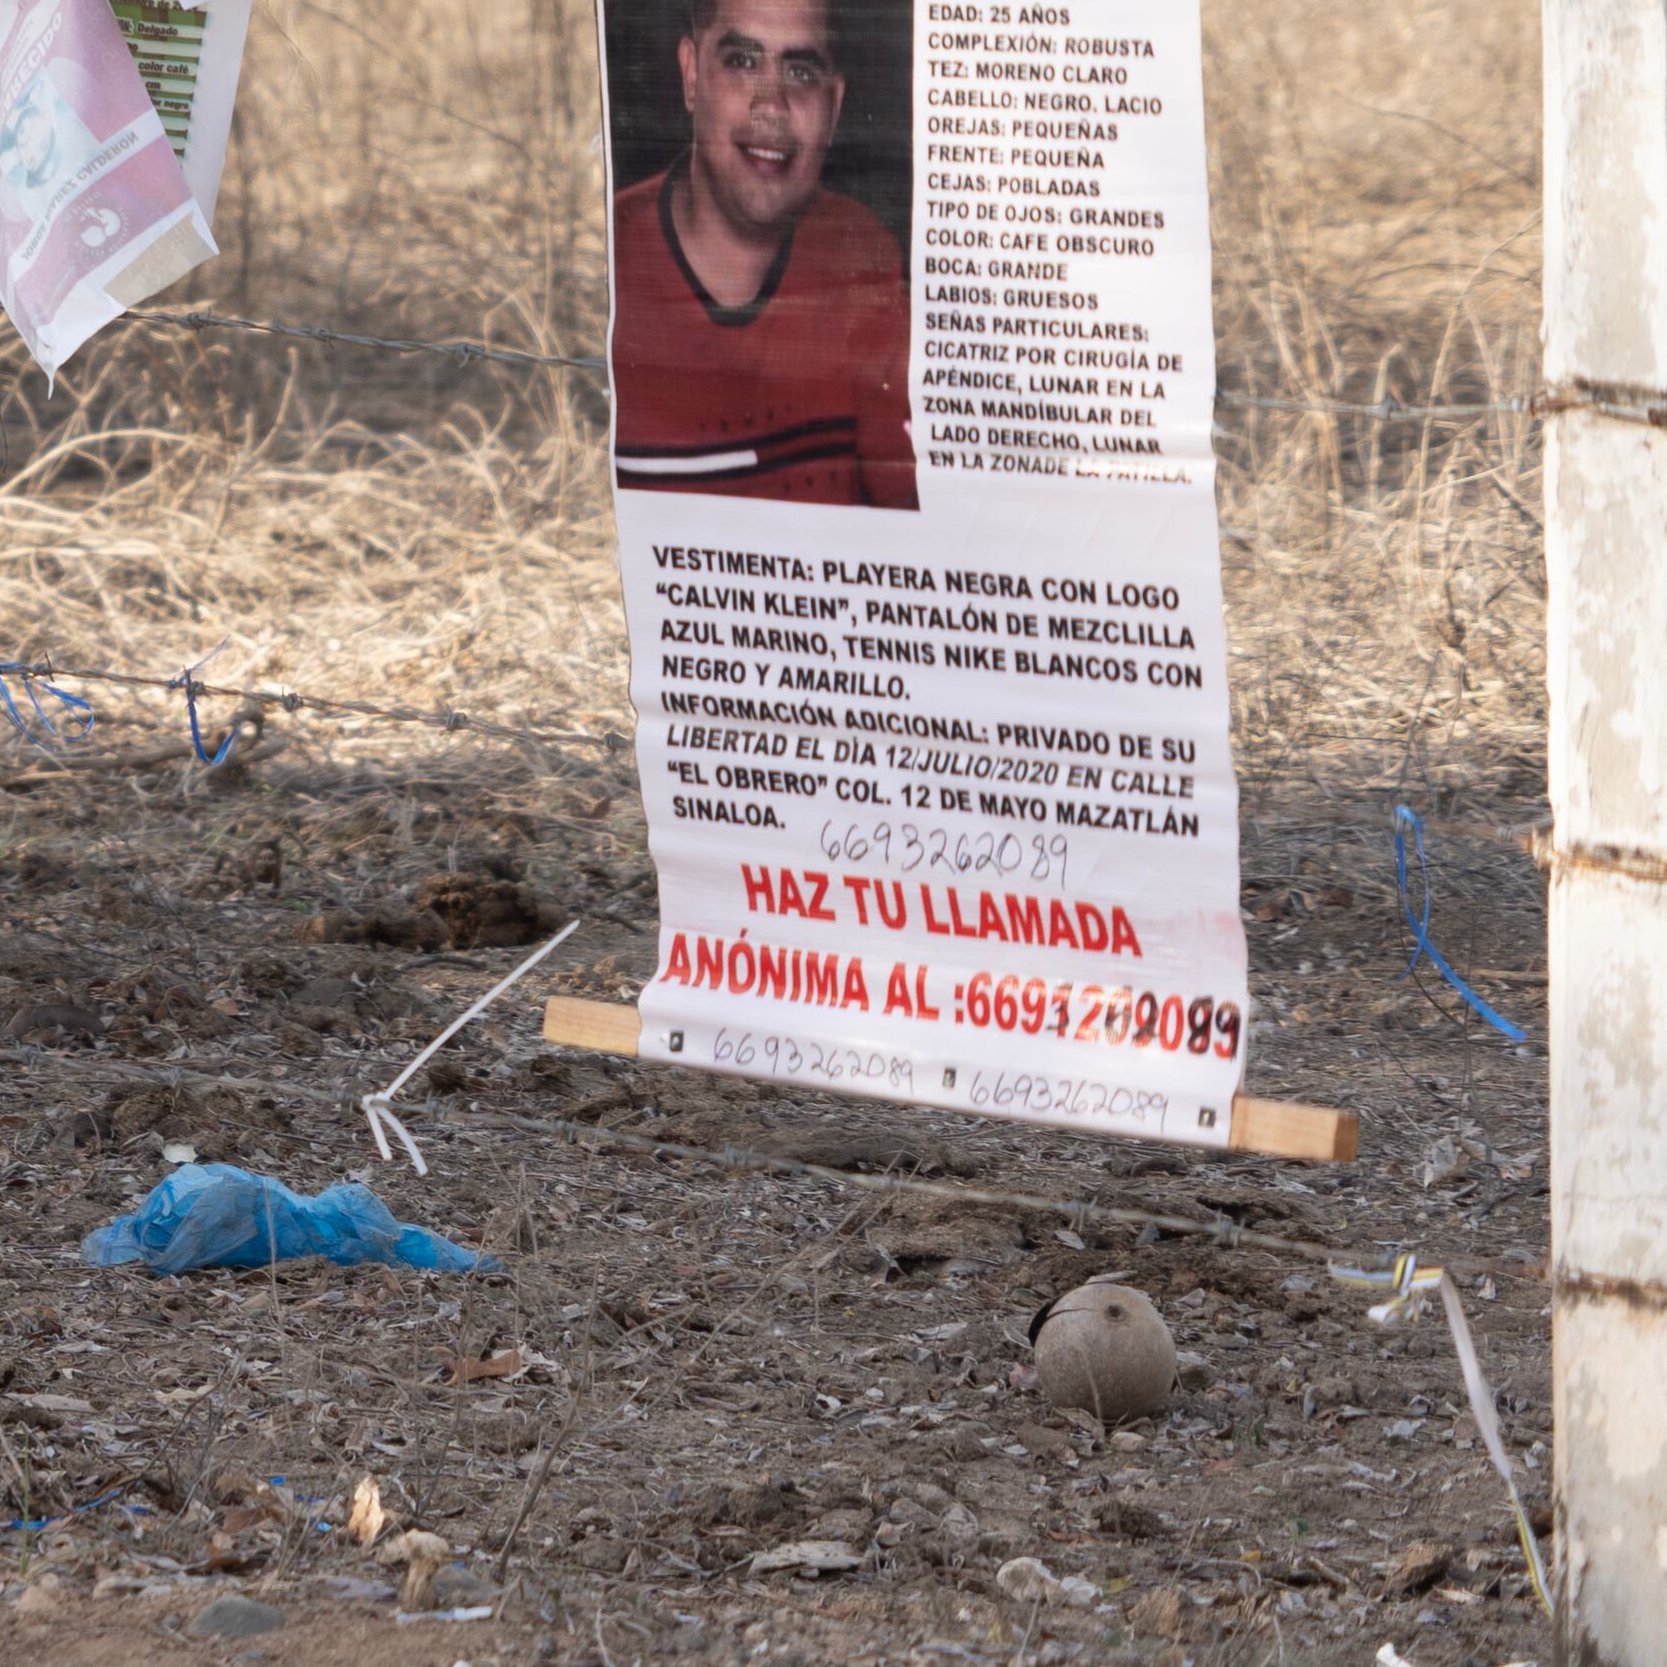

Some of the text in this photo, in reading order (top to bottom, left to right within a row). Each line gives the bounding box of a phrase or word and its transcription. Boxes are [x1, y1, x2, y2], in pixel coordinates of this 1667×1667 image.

[928, 2, 1071, 25] EDAD: 25 AÑOS
[138, 22, 179, 38] Delgado
[928, 33, 1155, 57] COMPLEXIÓN: ROBUSTA
[138, 61, 190, 74] color café
[928, 61, 1128, 84] TEZ: MORENO CLARO
[163, 100, 189, 111] negro
[927, 89, 1019, 108] CABELLO:
[1104, 97, 1163, 114] LACIO
[927, 117, 1118, 141] OREJAS: PEQUEÑAS
[927, 145, 1105, 168] FRENTE: PEQUEÑA
[927, 173, 1101, 197] CEJAS: POBLADAS
[926, 201, 1165, 228] TIPO DE OJOS: GRANDES
[925, 229, 994, 247] COLOR:
[1056, 236, 1155, 255] OBSCURO
[924, 257, 1069, 280] BOCA: GRANDE
[924, 285, 1099, 309] LABIOS: GRUESOS
[925, 310, 1150, 341] SEÑAS PARTICULARES:
[924, 341, 1183, 371] CICATRIZ POR CIRUGÍA DE
[922, 368, 1166, 398] APÉNDICE, LUNAR EN LA
[923, 397, 976, 415] ZONA
[1120, 410, 1157, 426] DEL
[931, 425, 1162, 454] LADO DERECHO, LUNAR
[928, 452, 955, 466] EN
[960, 453, 984, 469] LA
[652, 546, 1180, 610] VESTIMENTA: PLAYERA NEGRA CON LOGO
[865, 601, 998, 633] PANTALÓN
[1005, 613, 1039, 637] DE
[1047, 616, 1195, 649] MEZCLILLA
[660, 619, 1203, 687] AZUL MARINO, TENNIS NIKE BLANCOS CON
[662, 655, 911, 699] NEGRO Y AMARILLO.
[660, 692, 1196, 763] INFORMACIÓN ADICIONAL: PRIVADO DE SU
[666, 725, 788, 756] LIBERTAD
[795, 736, 825, 760] EL
[885, 745, 1060, 785] 12/JULIO/2020
[1066, 765, 1103, 789] EN
[1110, 769, 1194, 798] CALLE
[672, 796, 786, 828] SINALOA.
[835, 777, 892, 805] COL.
[901, 784, 931, 808] 12
[939, 788, 974, 811] DE
[978, 793, 1047, 821] MAYO
[1055, 801, 1199, 837] MAZATLÁN
[819, 819, 1068, 890] 6693262089
[741, 863, 1144, 958] HAZ TU LLAMADA
[659, 928, 870, 1013] ANÓNIMA
[883, 963, 940, 1021] AL
[713, 1026, 1170, 1138] 6693262089 6693262089
